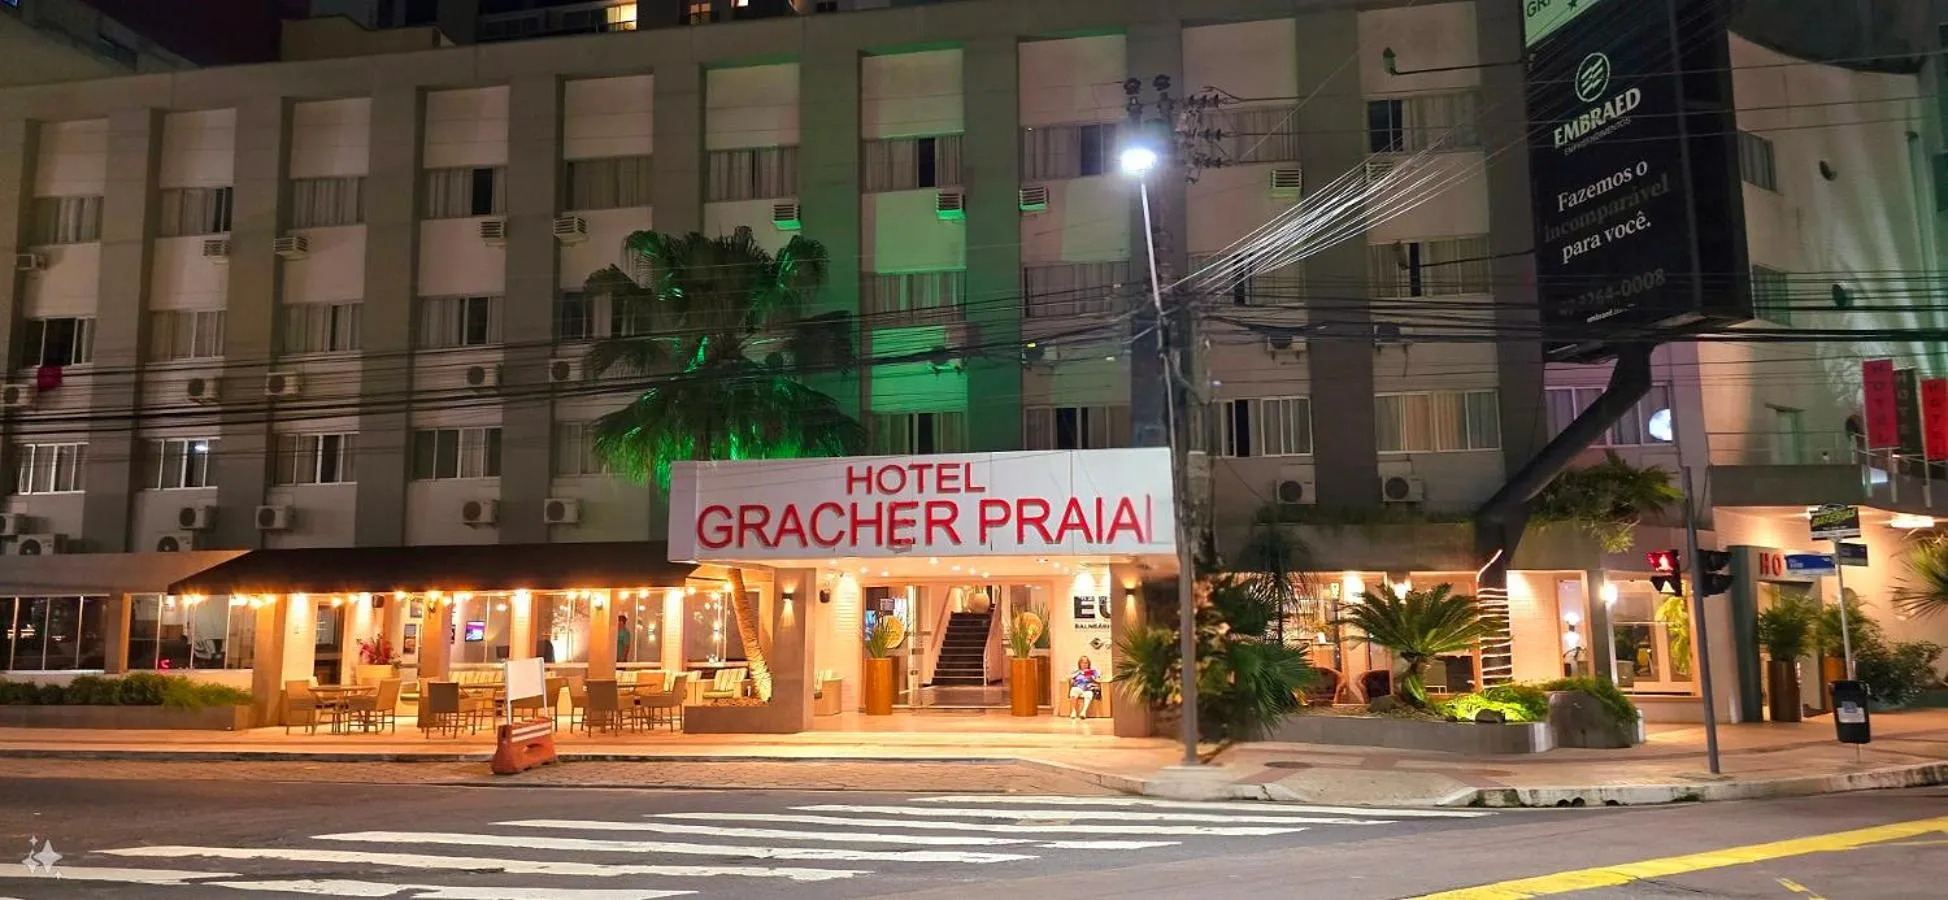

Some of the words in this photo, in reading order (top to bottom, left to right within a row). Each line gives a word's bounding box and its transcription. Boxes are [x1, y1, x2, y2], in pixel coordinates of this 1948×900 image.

[1553, 87, 1642, 149] EMBRAED
[1557, 167, 1633, 213] Fazemos
[1635, 160, 1649, 177] o
[1562, 232, 1602, 264] para
[1604, 210, 1652, 244] você.
[845, 461, 985, 496] HOTEL
[695, 497, 963, 550] GRACHER
